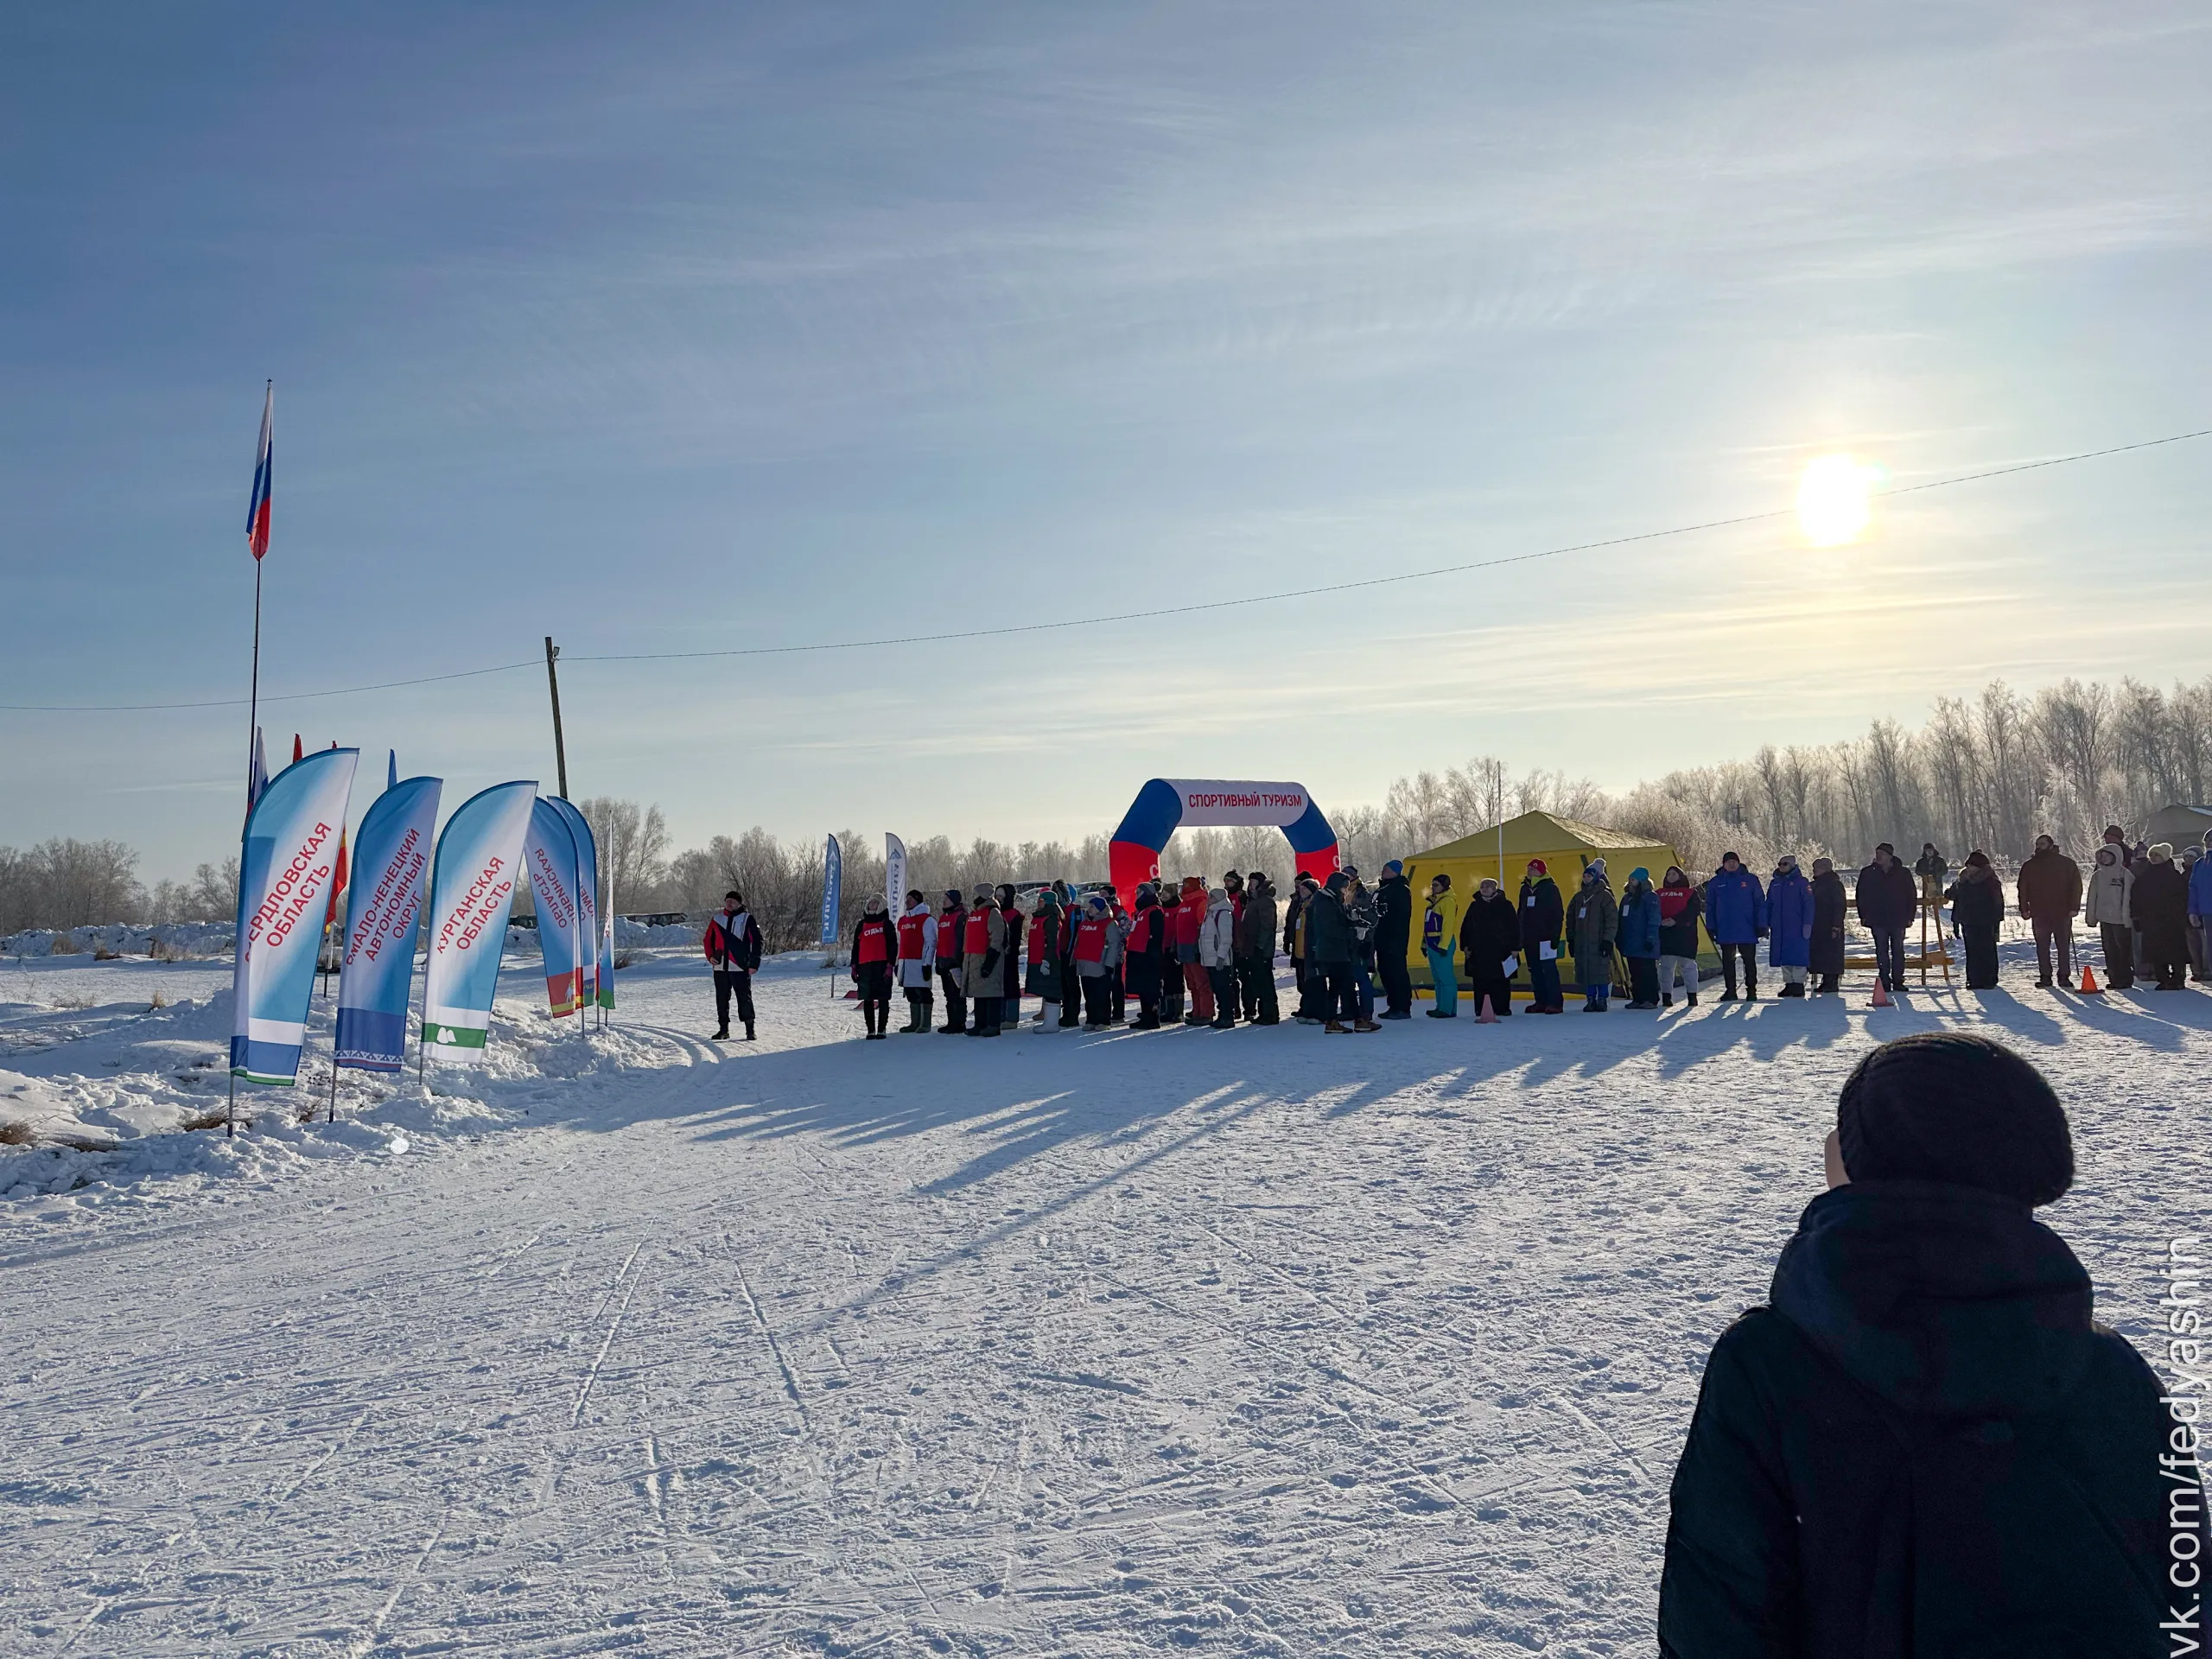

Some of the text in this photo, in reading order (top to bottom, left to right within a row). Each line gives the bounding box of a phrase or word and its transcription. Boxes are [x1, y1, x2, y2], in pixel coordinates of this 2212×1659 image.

[1188, 791, 1302, 808] СПОРТИВНЫЙ ТУРИЗМ
[245, 822, 332, 963] ЕРДЛОВСКАЯ
[266, 865, 330, 947] ОБЛАСТЬ
[365, 852, 426, 963] АВТОНОМНЫЙ
[392, 890, 422, 939] ОКРУГ
[436, 856, 505, 954] КУРГАНСКАЯ
[456, 881, 512, 950] ОБЛАСТЬ
[863, 926, 884, 937] СУДЬЯ
